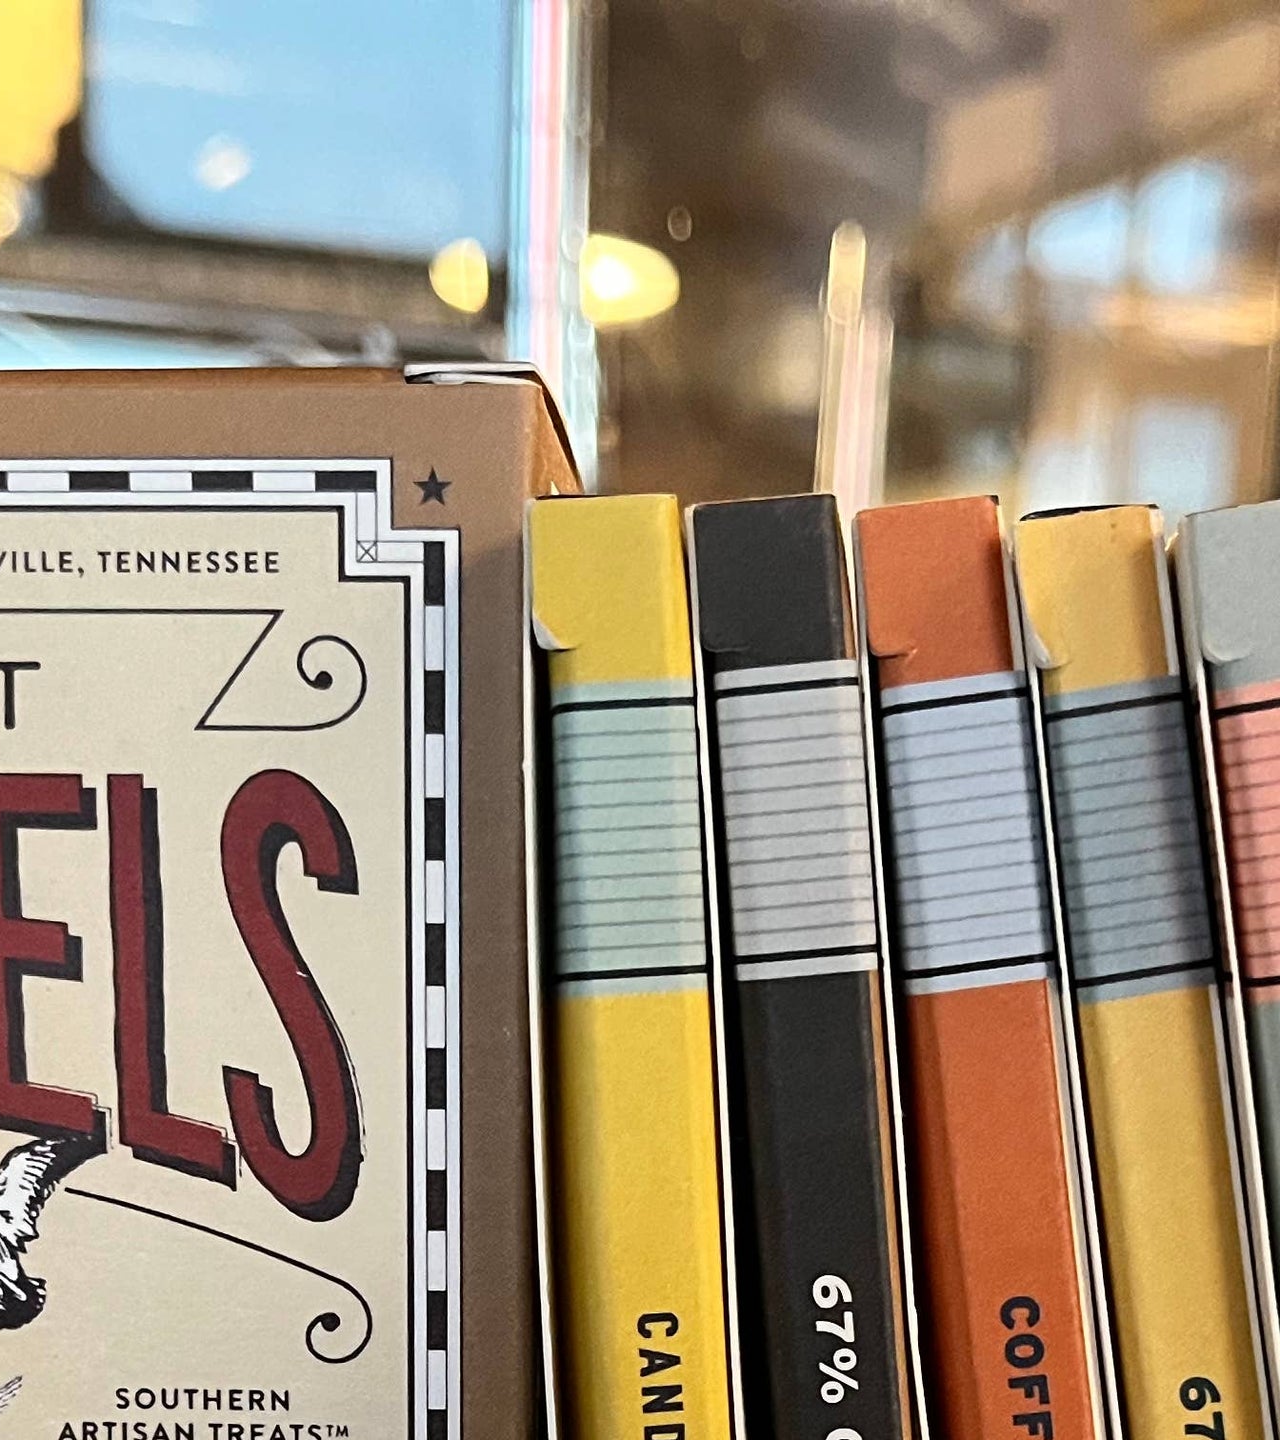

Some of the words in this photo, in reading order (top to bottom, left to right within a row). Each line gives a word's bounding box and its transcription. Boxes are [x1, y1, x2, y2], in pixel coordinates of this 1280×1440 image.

[98, 551, 281, 575] TENNESSEE
[812, 1274, 860, 1404] 67%
[115, 1388, 290, 1411] SOUTHERN
